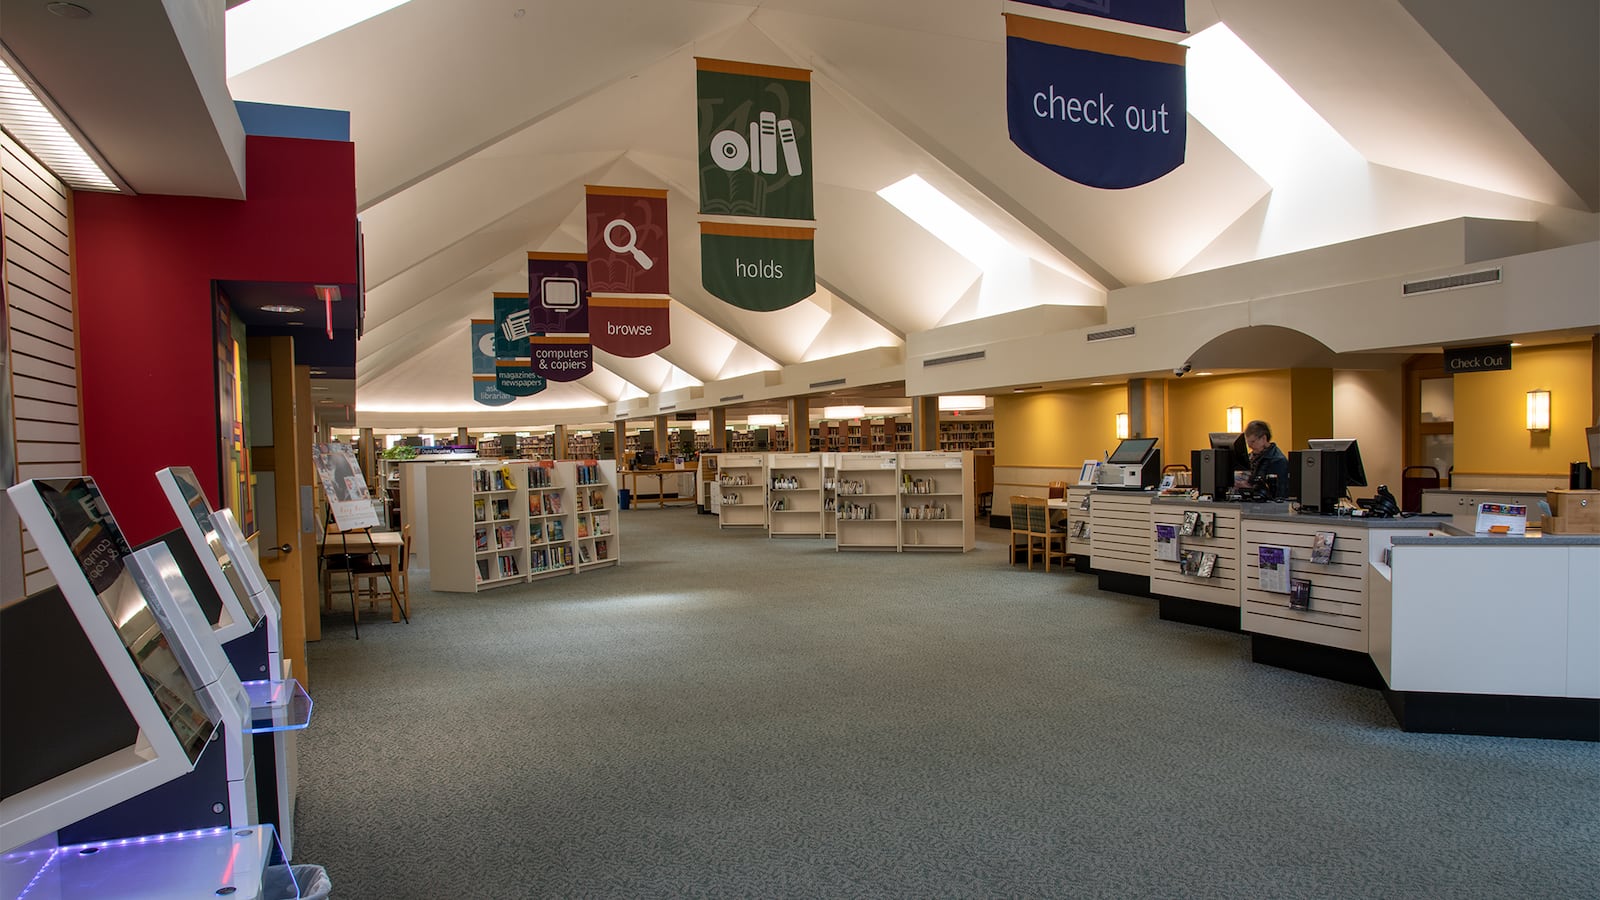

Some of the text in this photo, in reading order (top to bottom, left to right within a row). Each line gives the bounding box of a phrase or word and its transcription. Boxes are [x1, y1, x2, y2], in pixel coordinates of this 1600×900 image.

[1033, 85, 1170, 135] check out
[735, 258, 783, 279] holds
[607, 321, 653, 336] browse
[535, 347, 589, 361] computers
[538, 359, 587, 371] & copiers
[1450, 355, 1504, 369] Check Out
[498, 371, 536, 380] magazines
[501, 380, 542, 388] newspapers
[480, 391, 511, 400] librarian
